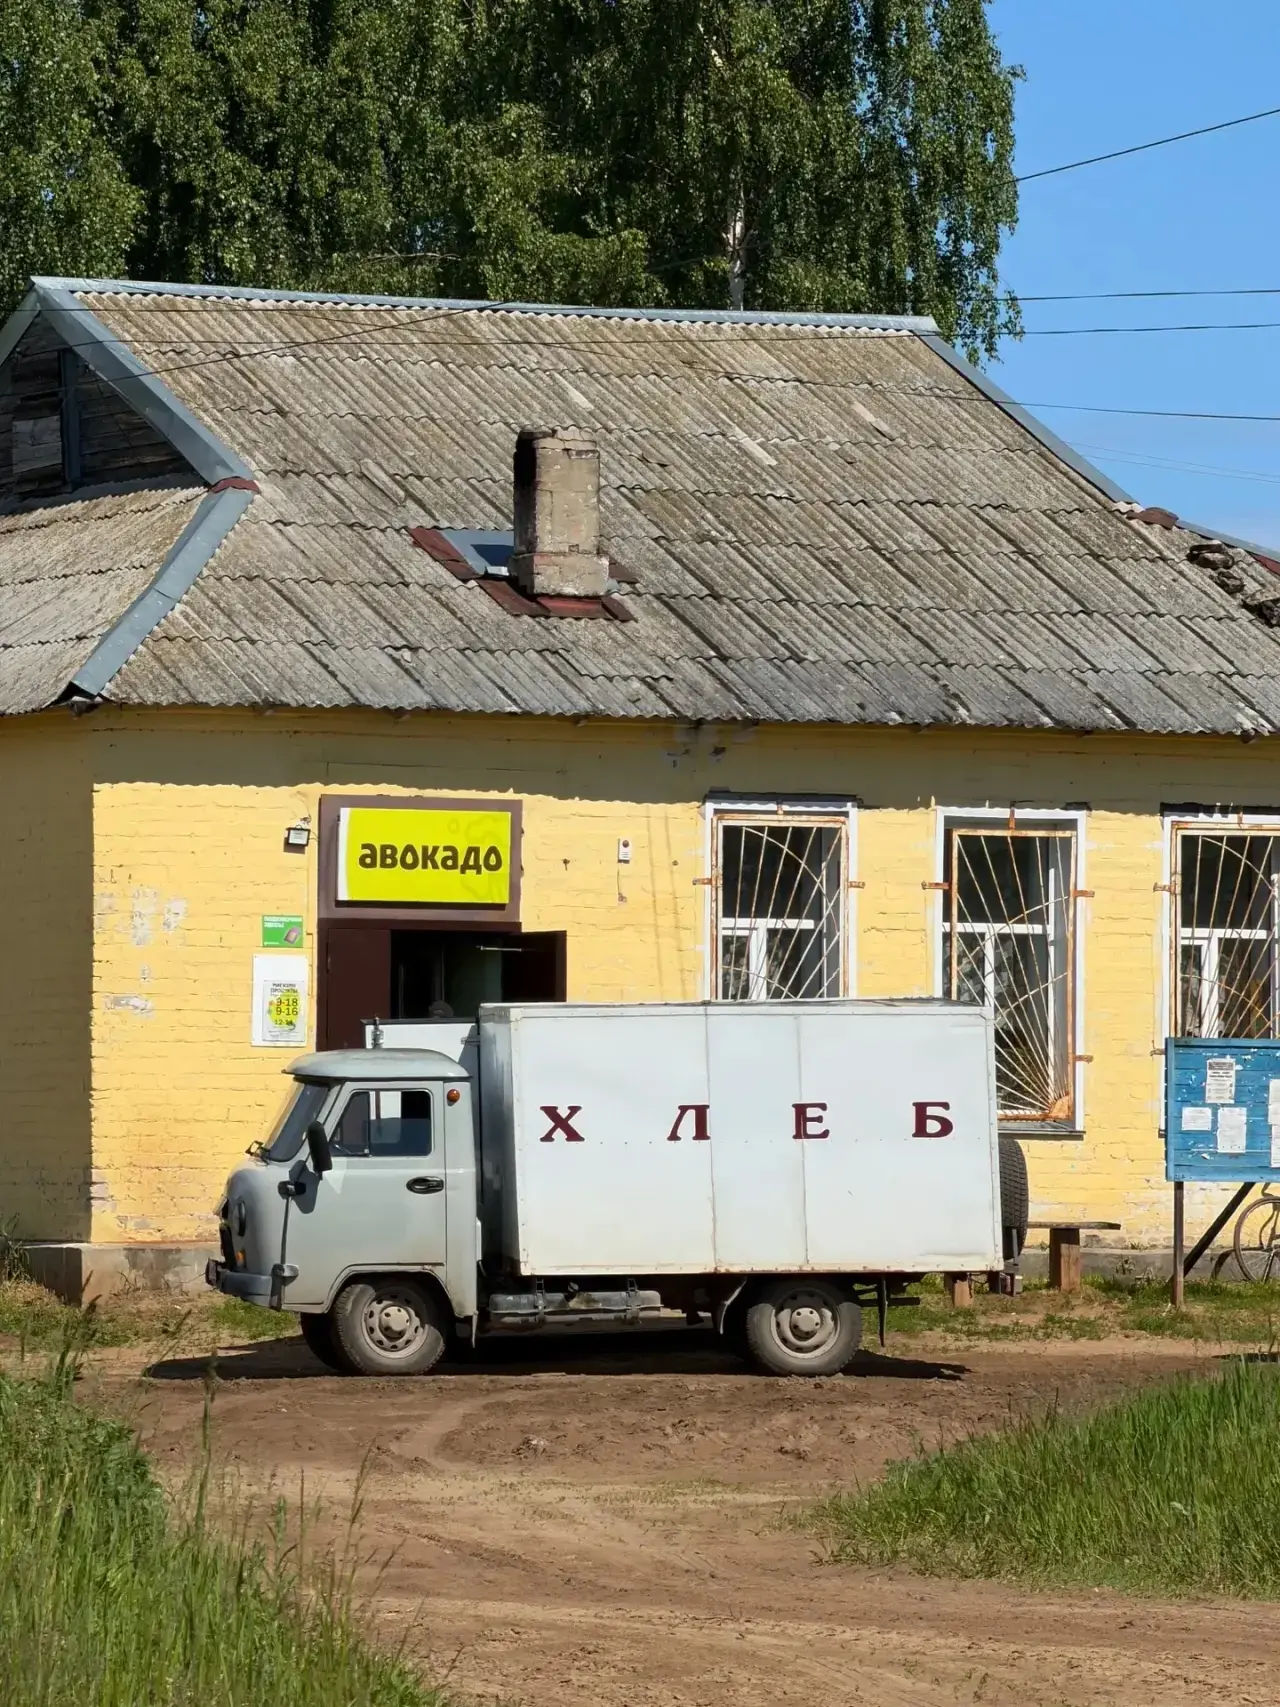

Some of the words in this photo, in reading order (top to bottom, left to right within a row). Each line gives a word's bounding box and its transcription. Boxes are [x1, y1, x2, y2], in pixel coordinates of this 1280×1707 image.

[358, 842, 503, 876] авокадо
[276, 998, 298, 1007] 9-18
[276, 1006, 299, 1016] 9-16
[538, 1101, 955, 1144] ХЛЕБ
